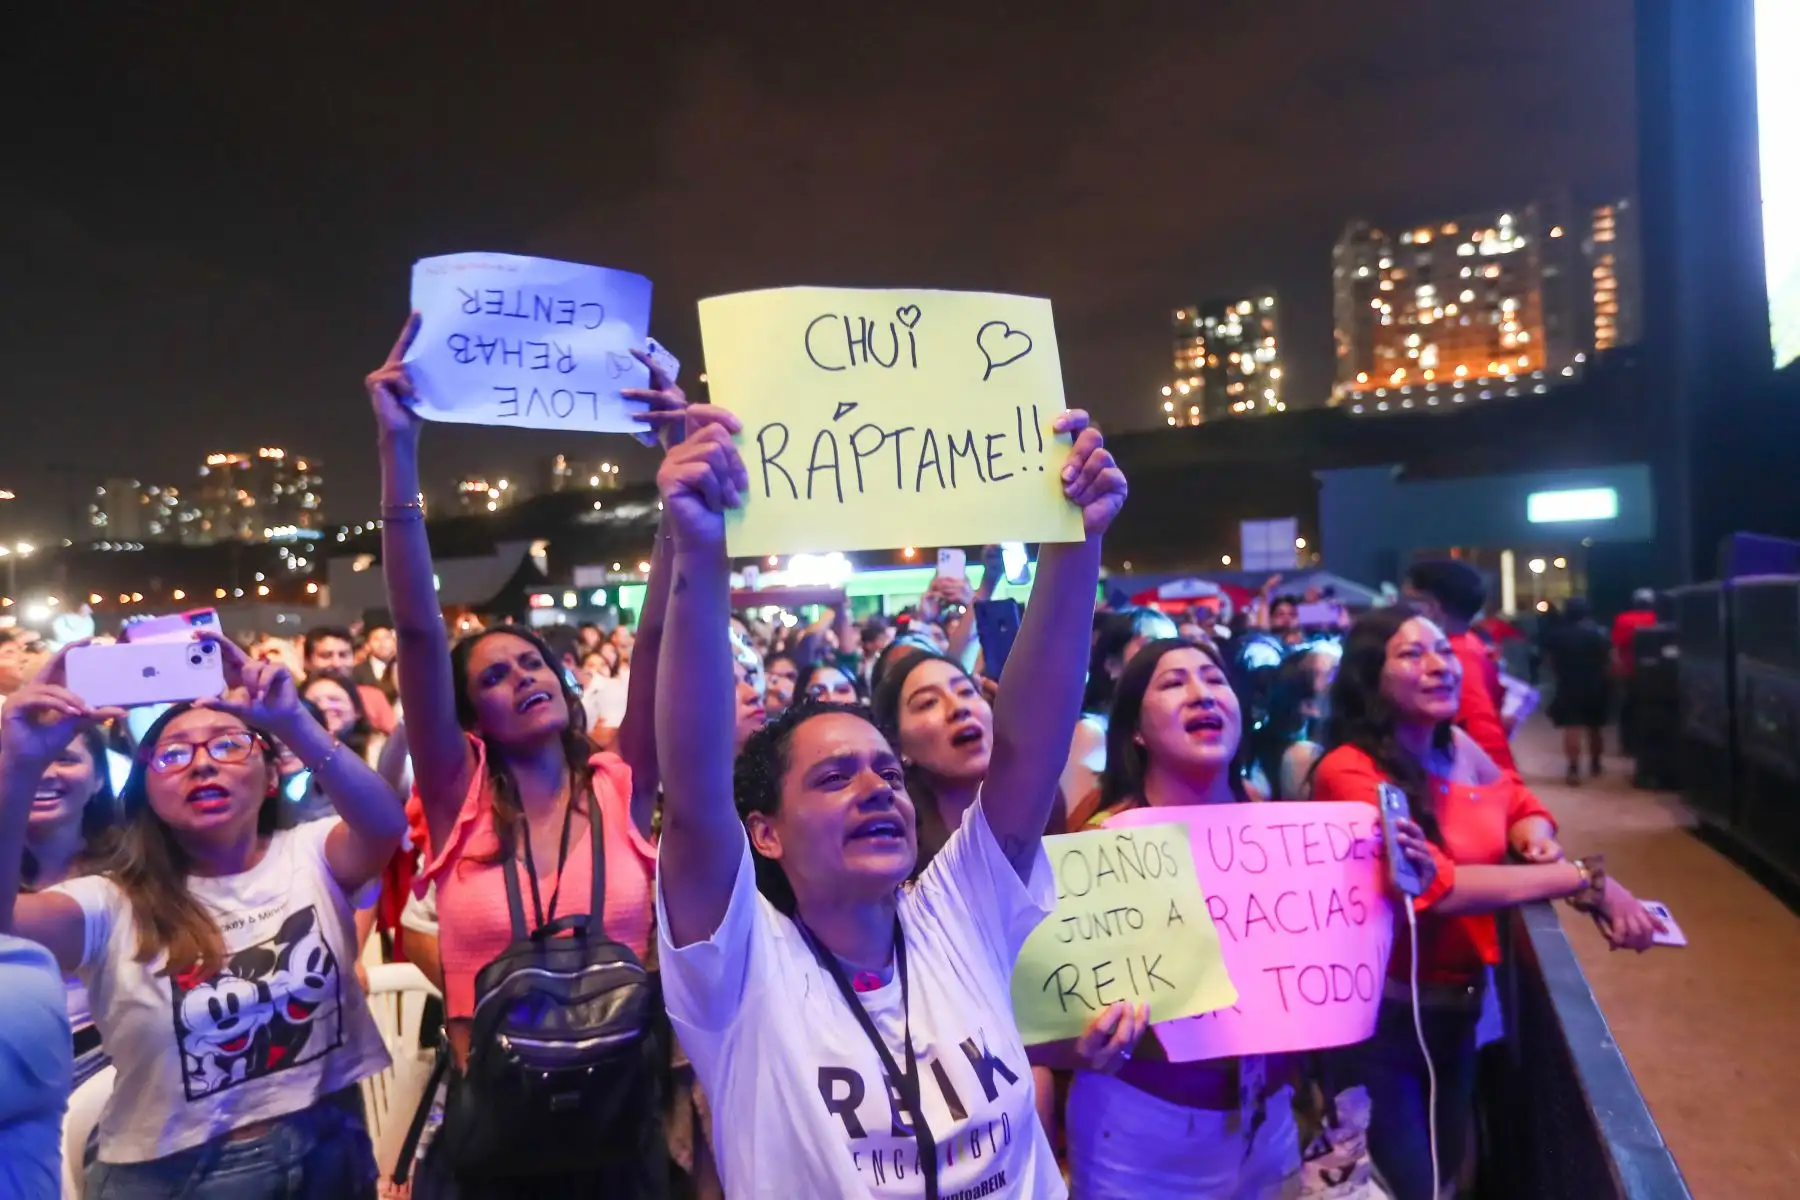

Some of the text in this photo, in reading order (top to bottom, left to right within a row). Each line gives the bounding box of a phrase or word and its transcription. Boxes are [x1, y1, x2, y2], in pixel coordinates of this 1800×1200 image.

[457, 286, 604, 329] CENTER
[447, 333, 578, 374] REHAB
[493, 387, 598, 421] LOVE
[757, 402, 1044, 503] RÁPTAME!!
[1055, 898, 1185, 943] JUNTO A
[1205, 886, 1367, 942] RACIAS
[1043, 954, 1175, 1013] REIK
